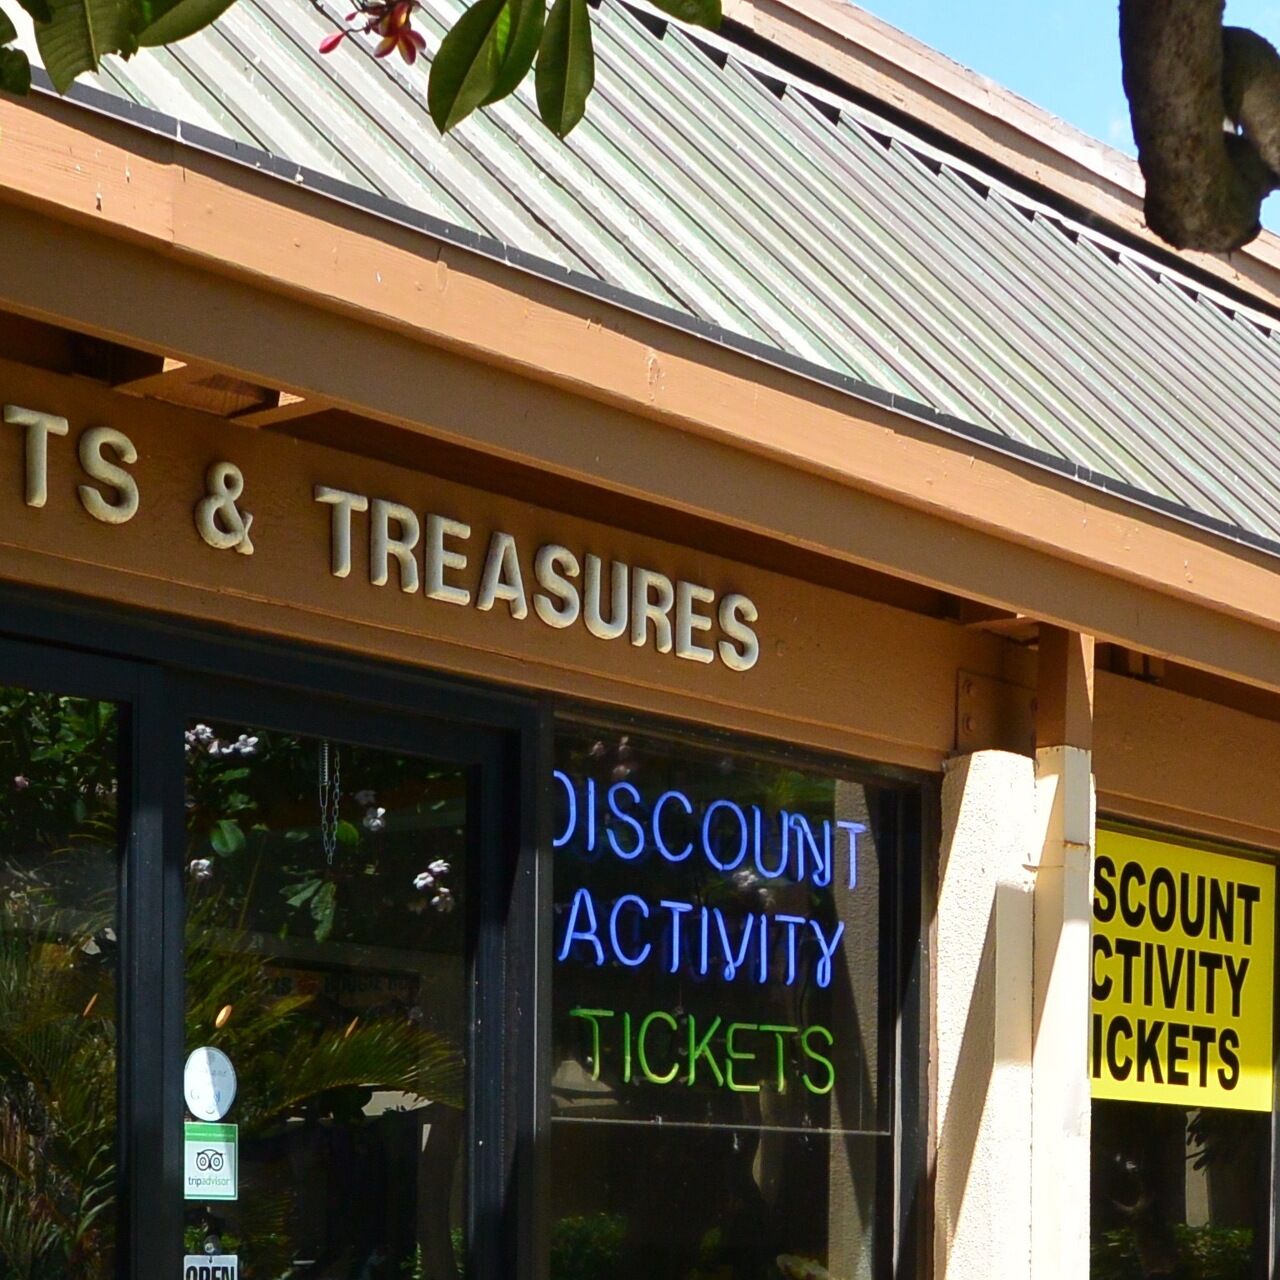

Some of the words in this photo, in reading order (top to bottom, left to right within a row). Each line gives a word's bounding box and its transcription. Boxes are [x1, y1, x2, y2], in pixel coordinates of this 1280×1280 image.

[195, 462, 255, 555] &
[315, 485, 760, 671] TREASURES
[553, 770, 866, 890] DISCOUNT
[558, 888, 845, 988] ACTIVITY
[1093, 855, 1261, 945] SCOUNT
[1091, 934, 1250, 1018] CTIVITY
[570, 1008, 835, 1094] TICKETS
[1092, 1014, 1240, 1091] ICKETS
[188, 1176, 231, 1188] tripadvisor
